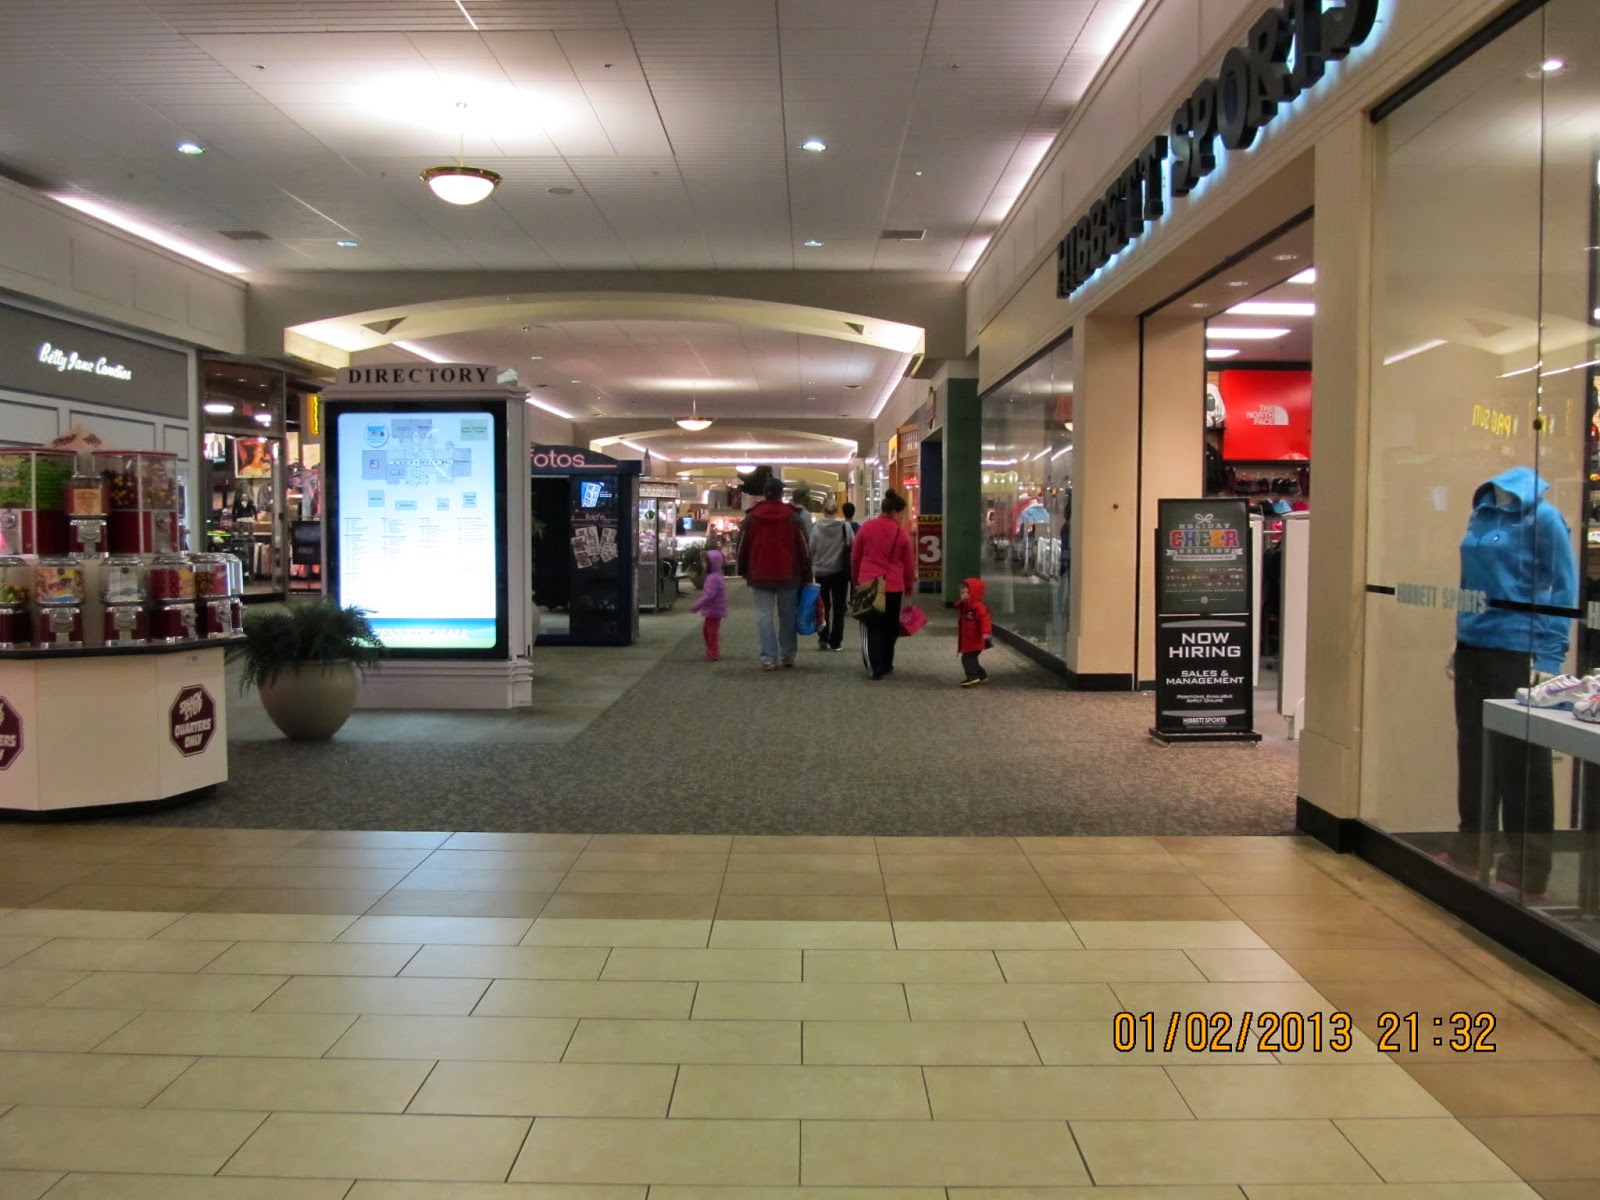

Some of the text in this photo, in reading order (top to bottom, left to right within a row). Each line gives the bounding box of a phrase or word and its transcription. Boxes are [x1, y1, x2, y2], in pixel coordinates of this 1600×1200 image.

[1057, 135, 1168, 298] HIBBETT
[39, 343, 132, 380] Betty Jane Candies
[348, 367, 489, 383] DIRECTORY
[1170, 529, 1239, 548] CHEER
[919, 535, 942, 562] 3
[1182, 632, 1229, 644] NOW
[1169, 646, 1241, 658] HIRING
[1166, 677, 1244, 685] MANAGEMENT
[174, 718, 212, 738] QUARTERS
[184, 733, 203, 748] ONLY
